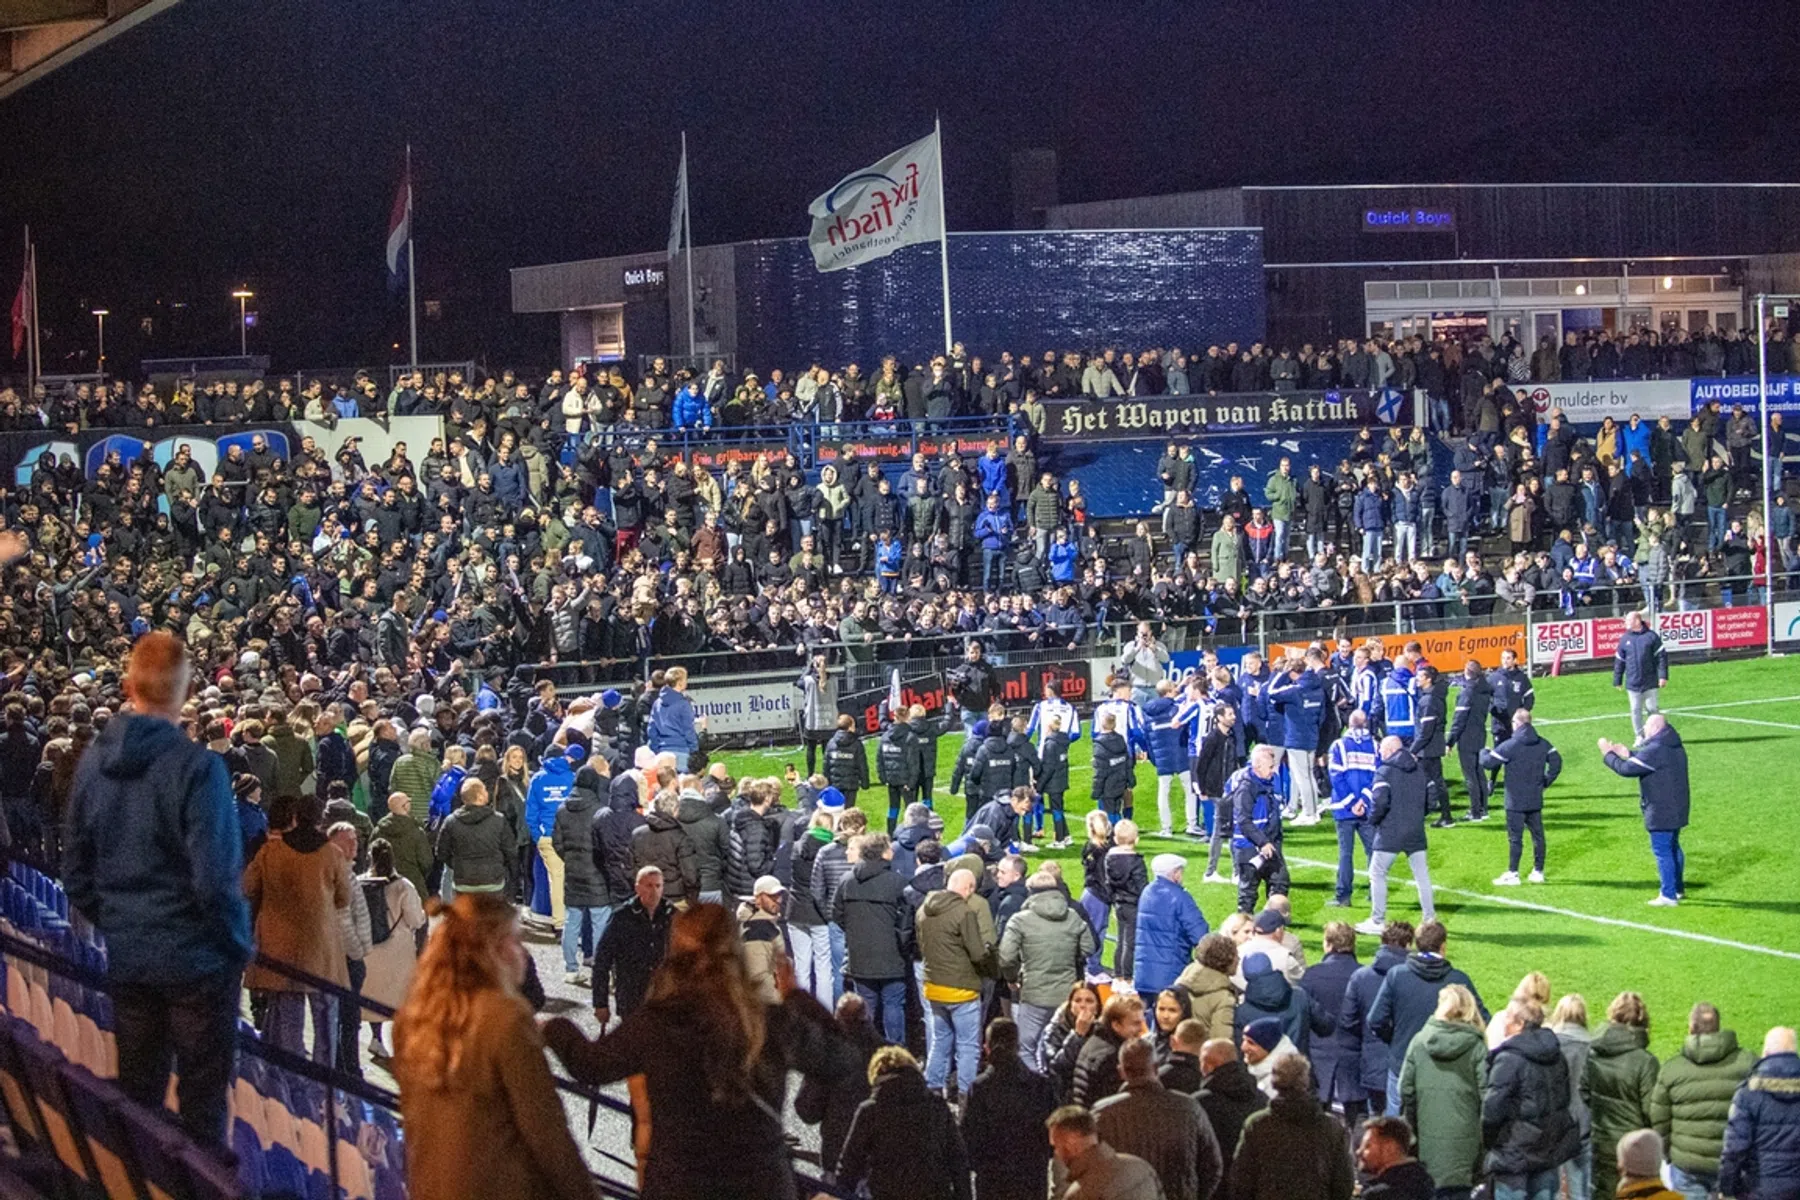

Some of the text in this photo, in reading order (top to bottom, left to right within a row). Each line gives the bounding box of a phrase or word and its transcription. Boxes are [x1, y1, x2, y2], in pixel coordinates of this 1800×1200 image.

[1366, 210, 1451, 226] Quick Boys
[624, 269, 664, 285] Quick Boys
[1554, 389, 1628, 408] mulder bv
[1061, 405, 1109, 436] Het
[1115, 402, 1208, 431] Wapen
[1215, 405, 1261, 425] van
[1660, 612, 1703, 630] ZECO
[1537, 622, 1583, 640] ZECO
[1659, 625, 1704, 641] isolatie
[1425, 639, 1453, 653] Van
[1458, 631, 1518, 654] Egmond
[747, 694, 791, 713] Bock
